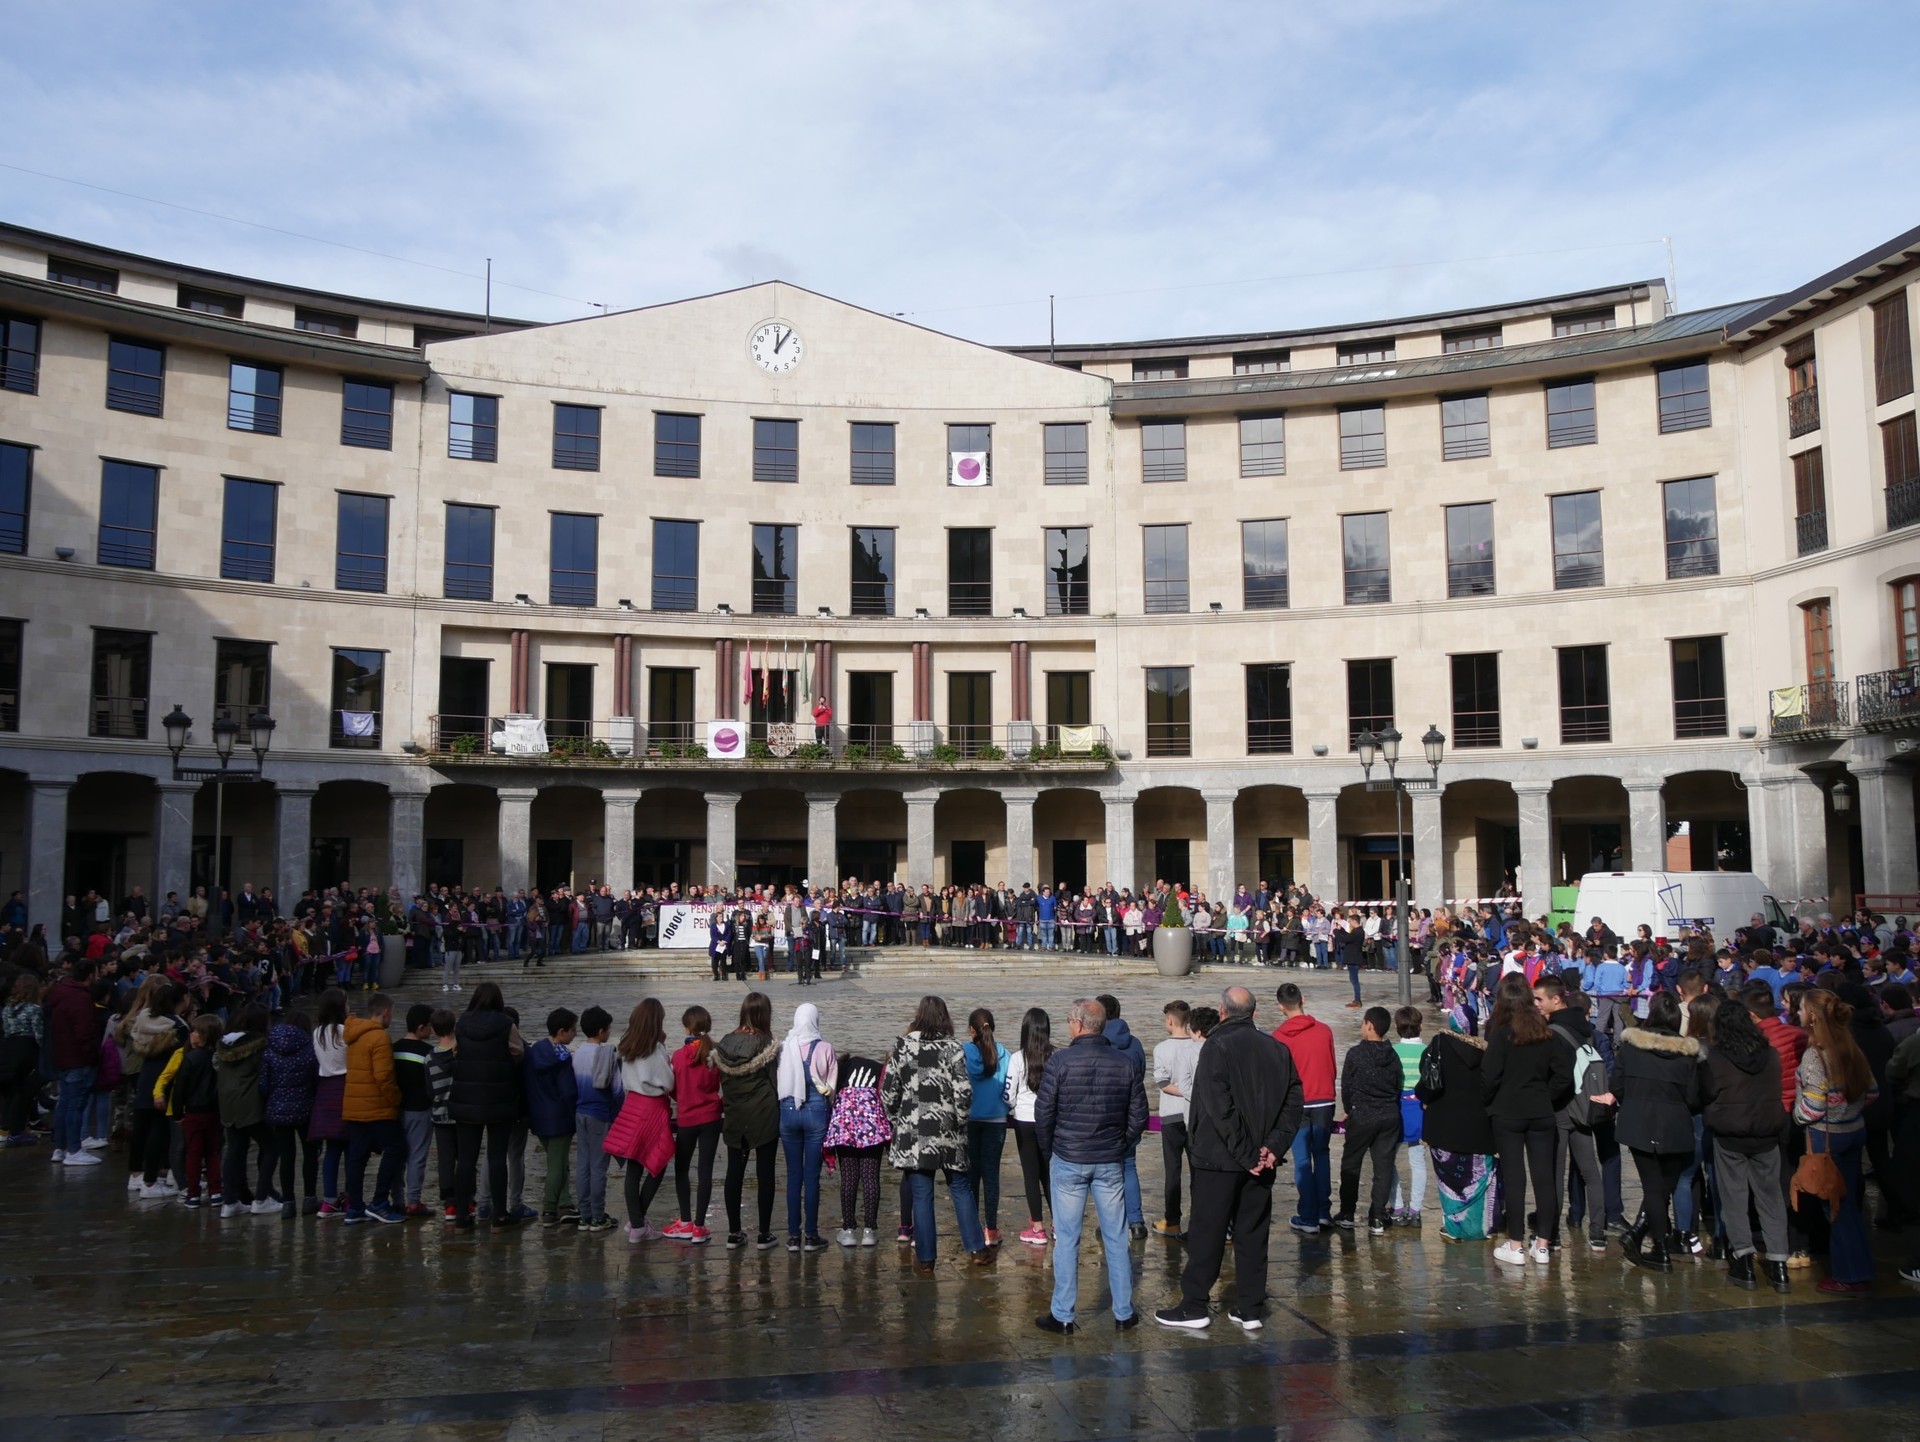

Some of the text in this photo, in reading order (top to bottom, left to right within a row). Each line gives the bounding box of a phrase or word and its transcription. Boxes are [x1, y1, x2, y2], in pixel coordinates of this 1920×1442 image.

[764, 328, 770, 336] 11
[773, 325, 781, 333] 12
[756, 335, 765, 343] 10
[662, 907, 687, 941] 1080€
